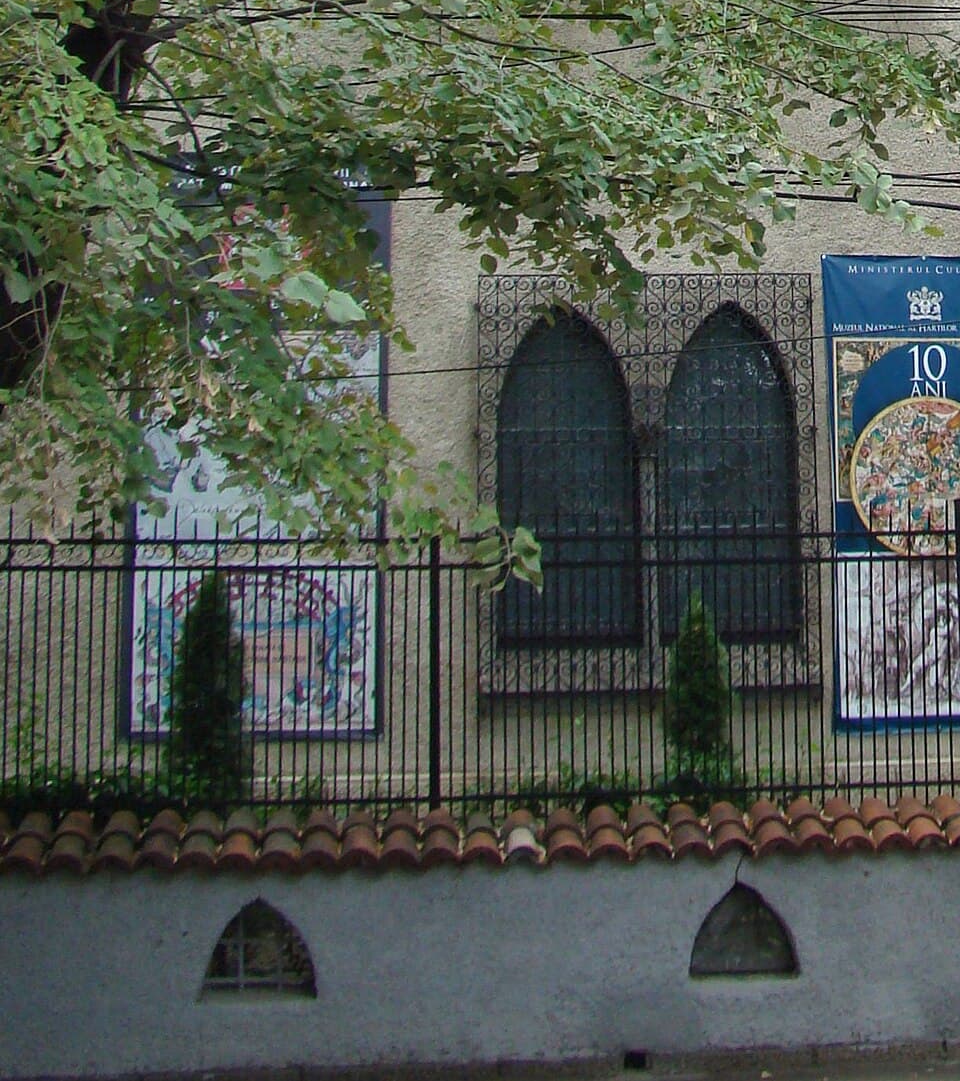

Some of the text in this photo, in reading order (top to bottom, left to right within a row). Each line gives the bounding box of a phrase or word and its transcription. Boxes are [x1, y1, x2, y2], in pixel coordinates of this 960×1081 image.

[848, 265, 930, 274] MINISTERUL
[907, 344, 947, 381] 10
[911, 381, 946, 399] ANI
